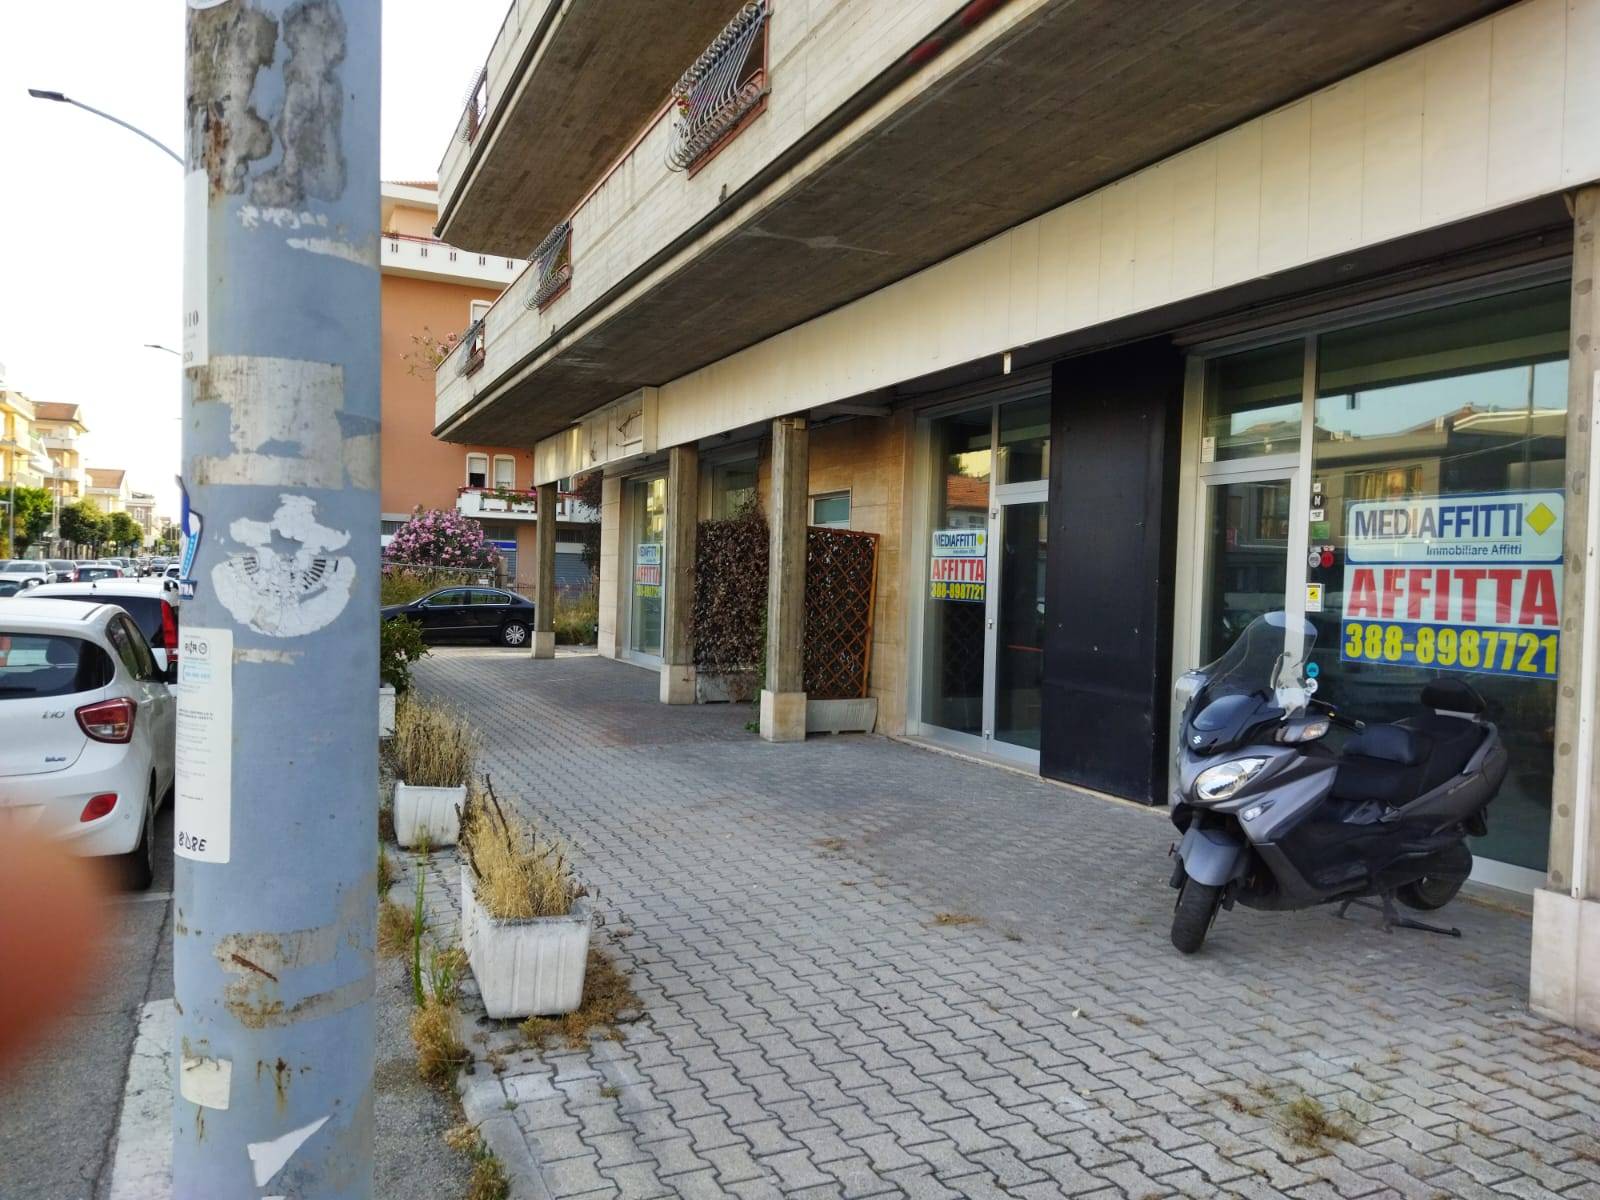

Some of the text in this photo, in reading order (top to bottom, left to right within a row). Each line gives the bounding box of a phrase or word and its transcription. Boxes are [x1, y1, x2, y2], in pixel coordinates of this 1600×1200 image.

[1354, 503, 1523, 540] MEDIAFFITTI
[1426, 544, 1522, 556] Immobiliare Affitti
[932, 559, 985, 581] AFFITTA
[1346, 568, 1559, 626] AFFITTA
[1345, 622, 1558, 674] 388-8987721
